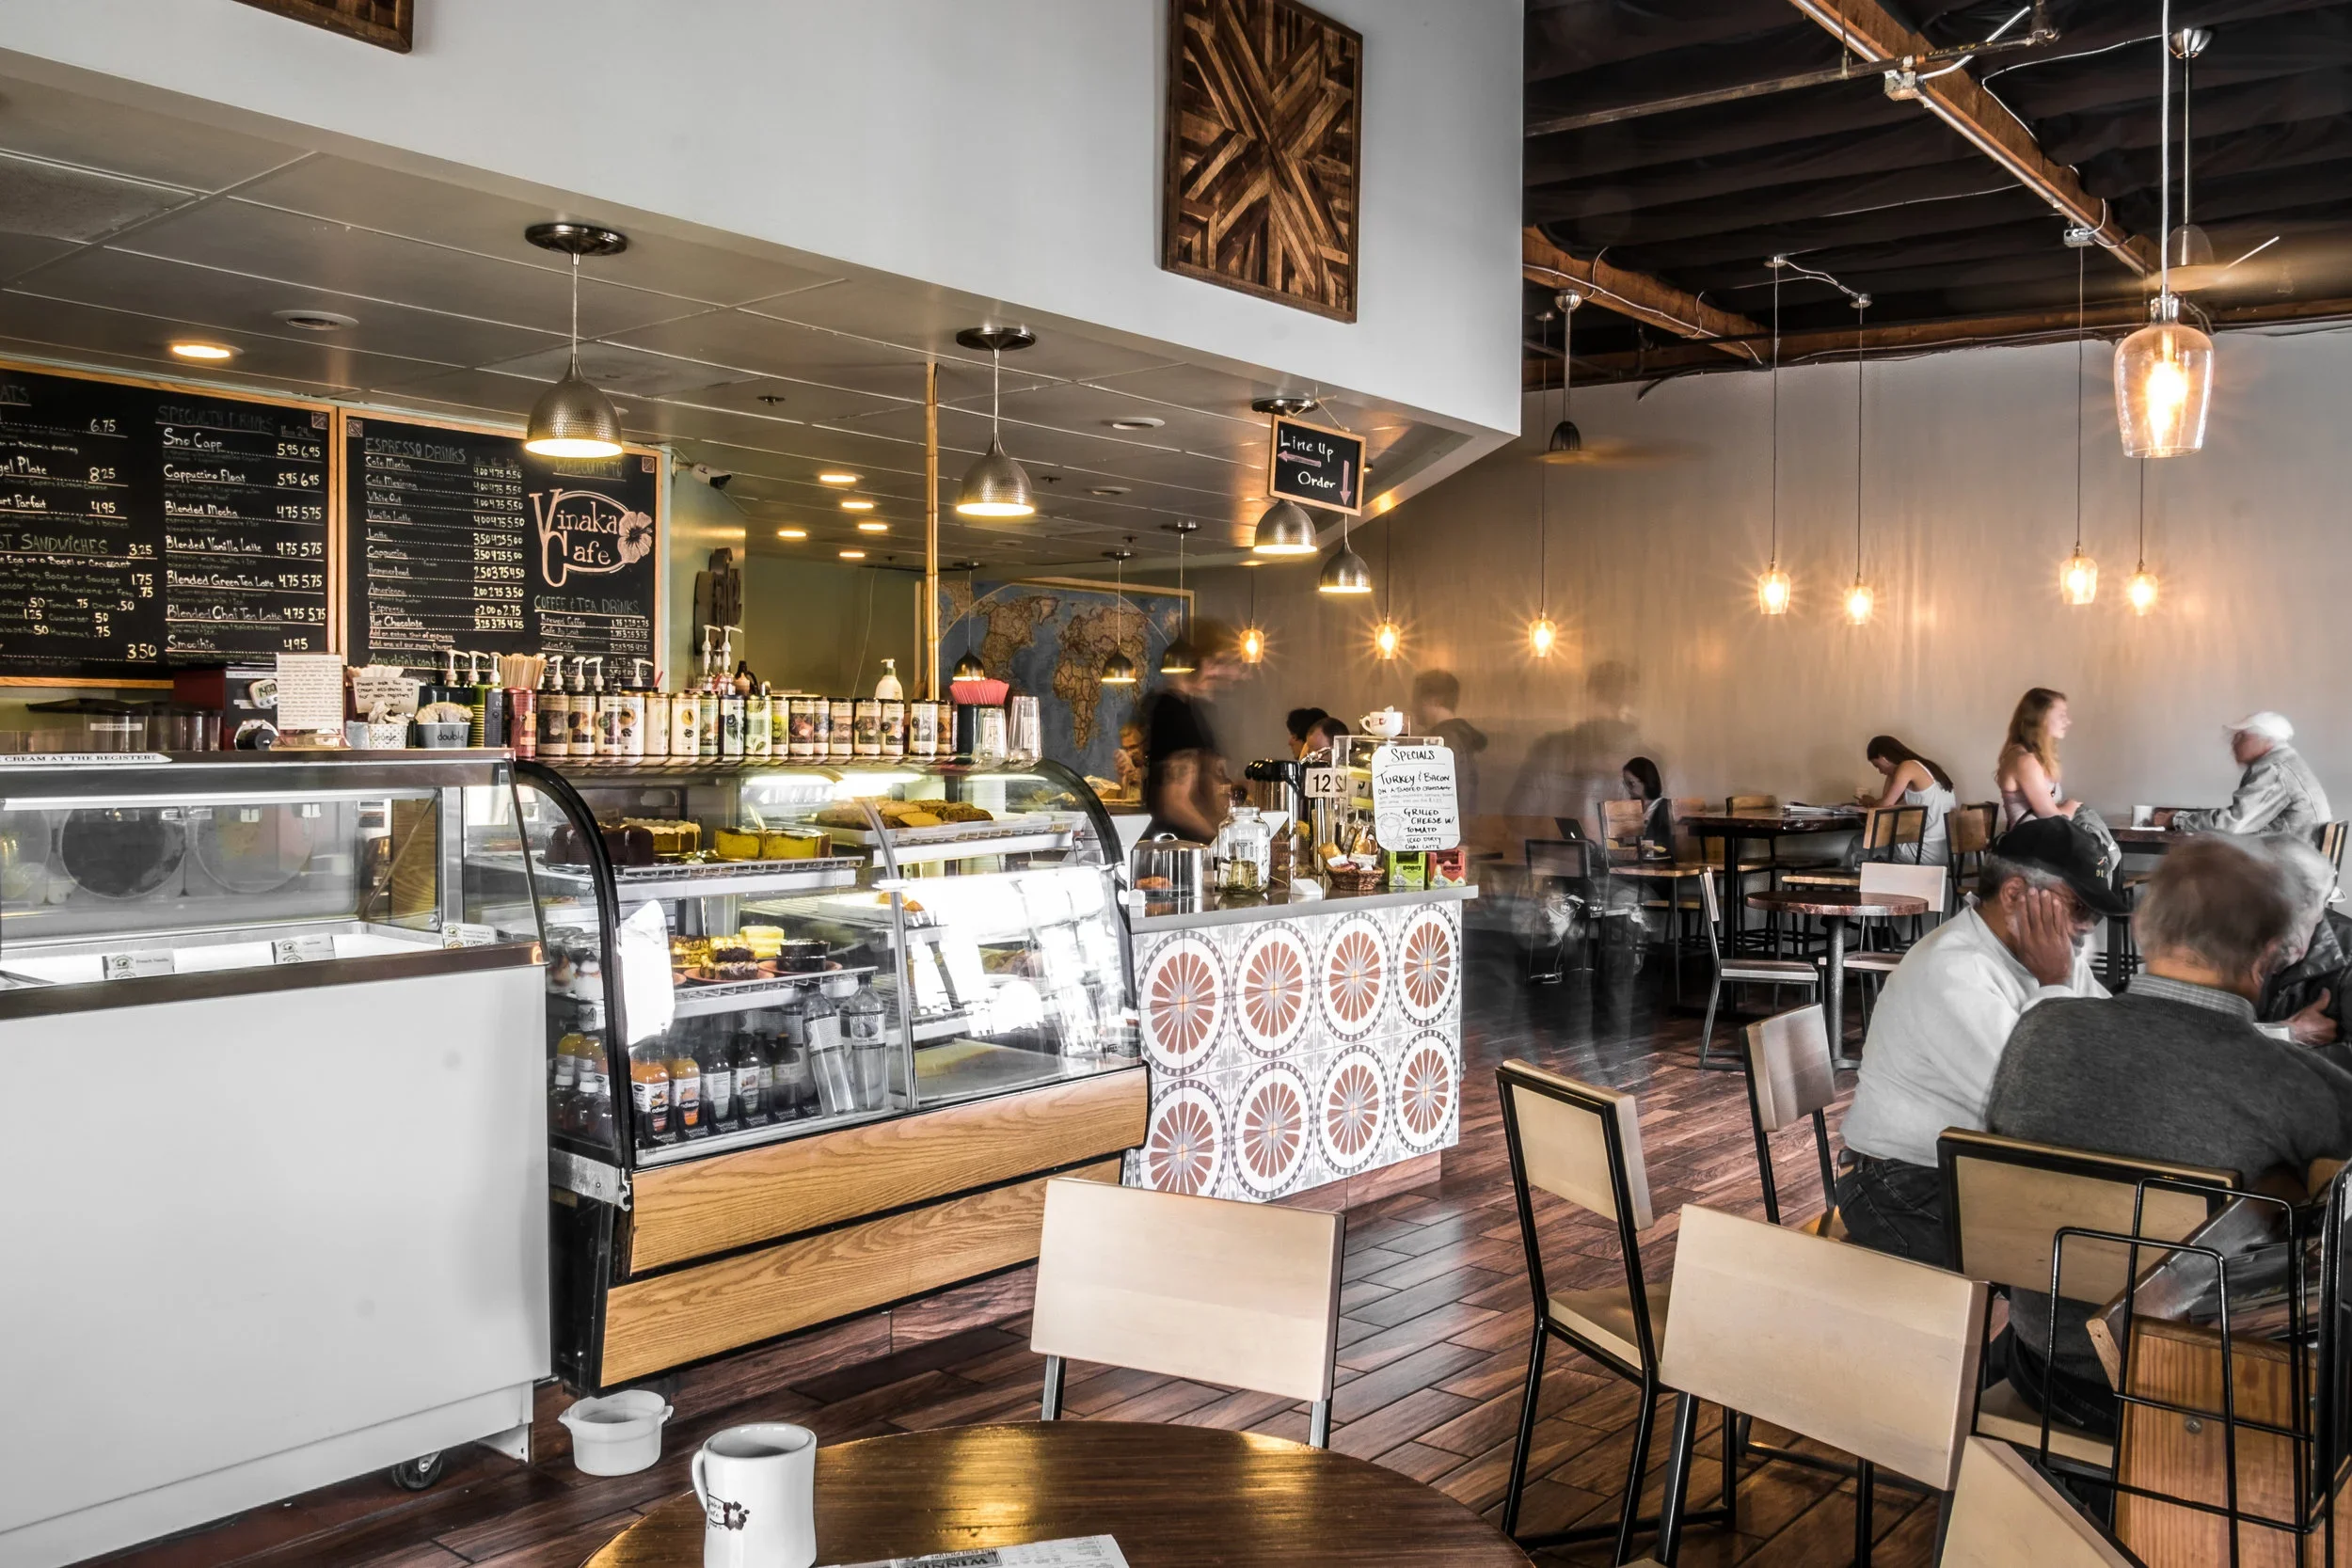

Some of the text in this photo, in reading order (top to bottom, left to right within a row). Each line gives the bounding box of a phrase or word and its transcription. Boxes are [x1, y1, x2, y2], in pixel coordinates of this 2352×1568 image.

[90, 419, 117, 433] 6.75
[162, 427, 190, 446] Sno
[194, 432, 223, 452] Capp
[365, 437, 422, 457] ESPRESSO
[1280, 430, 1334, 463] Line Up
[17, 456, 47, 475] Plate
[89, 467, 116, 483] 8.25
[163, 464, 217, 483] Cappuccino
[220, 468, 246, 483] Float
[1297, 471, 1336, 488] Order
[13, 494, 47, 509] Parfait
[165, 500, 204, 515] Blended
[208, 503, 239, 518] Mocha
[529, 488, 618, 535] Vinaka
[129, 543, 152, 556] 3.25
[165, 535, 205, 550] Blended
[207, 536, 239, 553] Vanilla
[542, 530, 612, 587] Cafe
[166, 570, 210, 586] Blended
[534, 594, 566, 610] COFFEE
[575, 597, 598, 612] TEA
[166, 604, 213, 622] Blended
[127, 642, 157, 659] 3.50
[167, 634, 216, 652] Smoothie
[437, 729, 464, 741] double
[1391, 748, 1436, 763] SPECIALS
[1312, 774, 1331, 793] 12
[1375, 769, 1415, 787] TURKEY
[1423, 771, 1450, 783] BACON
[1404, 807, 1439, 817] GRILLED
